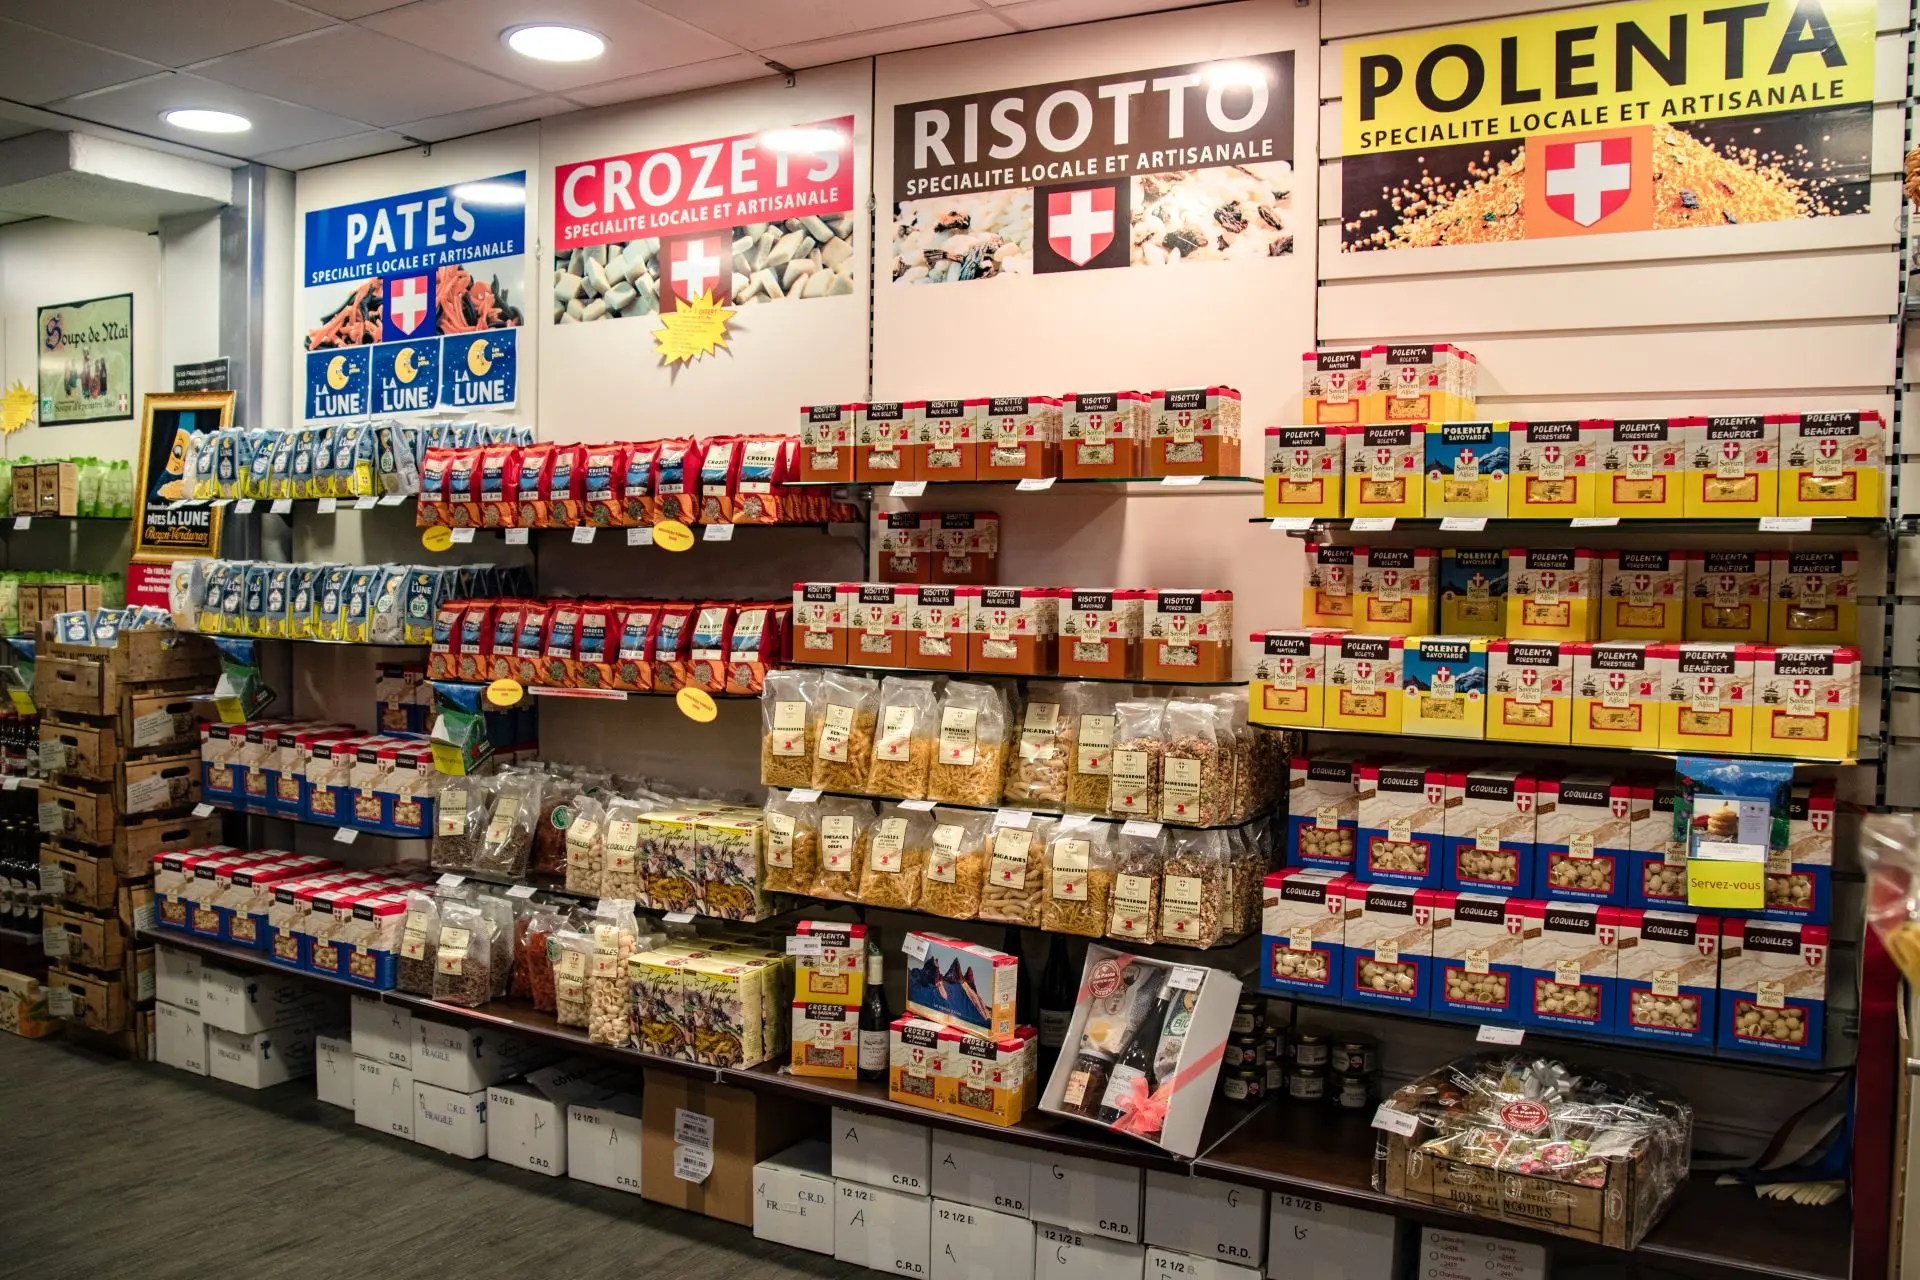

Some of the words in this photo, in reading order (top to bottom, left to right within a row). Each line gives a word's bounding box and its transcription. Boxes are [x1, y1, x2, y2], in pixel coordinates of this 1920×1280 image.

[1360, 0, 1849, 122] POLENTA
[915, 68, 1270, 170] RISOTTO
[1361, 118, 1499, 149] SPECIALITE
[1510, 106, 1608, 133] LOCALE
[1621, 101, 1650, 121] ET
[1661, 79, 1844, 117] ARTISANALE
[563, 128, 839, 217] CROZETS
[906, 168, 1014, 195] SPECIALITE
[1021, 158, 1098, 182] LOCALE
[1105, 155, 1128, 173] ET
[1137, 139, 1273, 169] ARTISANALE
[564, 216, 645, 239] SPECIALITE
[650, 207, 708, 227] LOCALE
[714, 203, 731, 219] ET
[737, 187, 838, 216] ARTISANALE
[347, 197, 475, 259] PATES
[312, 263, 372, 283] SPECIALITE
[377, 256, 418, 274] LOCALE
[423, 253, 436, 266] ET
[440, 241, 513, 263] ARTISANALE
[46, 315, 85, 350] Soupe
[89, 326, 100, 342] de
[102, 322, 128, 341] Mai
[1392, 348, 1427, 357] POLENTA
[1323, 354, 1355, 363] POLENTA
[455, 370, 469, 382] LA
[383, 378, 396, 389] LA
[316, 385, 329, 395] LA
[455, 380, 504, 404] LUNE
[383, 387, 428, 410] LUNE
[995, 398, 1022, 406] RISOTTO
[1171, 394, 1200, 402] RISOTTO
[315, 393, 359, 416] LUNE
[872, 403, 897, 411] RISOTTO
[931, 400, 958, 408] RISOTTO
[1714, 418, 1756, 426] POLENTA
[1806, 414, 1852, 422] POLENTA
[1369, 429, 1405, 437] POLENTA
[1443, 426, 1491, 435] POLENTA
[1533, 425, 1572, 433] POLENTA
[1620, 424, 1661, 432] POLENTA
[1804, 426, 1853, 435] BEAUFORT
[1286, 431, 1320, 439] POLENTA
[1712, 430, 1759, 439] BEAUFORT
[176, 511, 210, 526] LUNE
[1532, 553, 1568, 561] POLENTA
[1793, 565, 1837, 573] BEAUFORT
[412, 586, 432, 595] LUNE
[864, 587, 889, 595] RISOTTO
[923, 589, 948, 597] RISOTTO
[987, 590, 1014, 598] RISOTTO
[1164, 597, 1194, 605] RISOTTO
[1270, 639, 1304, 648] POLENTA
[1347, 642, 1383, 651] POLENTA
[1421, 644, 1467, 653] POLENTA
[1514, 648, 1552, 657] POLENTA
[1598, 652, 1638, 660] POLENTA
[1685, 651, 1728, 660] POLENTA
[1781, 653, 1826, 661] POLENTA
[1683, 665, 1729, 673] BEAUFORT
[1312, 768, 1346, 776] COQUILLES
[1383, 777, 1418, 786] COQUILLES
[1470, 785, 1508, 794] COQUILLES
[1564, 790, 1603, 800] COQUILLES
[1691, 878, 1761, 891] Servez-vous
[1286, 887, 1321, 897] COQUILLES
[1370, 898, 1407, 908] COQUILLES
[1460, 906, 1498, 917] COQUILLES
[1550, 917, 1590, 927] COQUILLES
[1647, 925, 1689, 937] COQUILLES
[1750, 935, 1793, 947] COQUILLES
[904, 1027, 935, 1037] CROZETS
[962, 1037, 994, 1048] CROZETS
[389, 1052, 407, 1063] C.R.D.
[422, 1048, 450, 1061] FRAGILE
[491, 1093, 498, 1101] 12
[500, 1095, 508, 1104] 1/2
[425, 1111, 454, 1126] FRAGILE
[583, 1115, 593, 1124] 1/2
[534, 1113, 545, 1137] A
[609, 1128, 618, 1145] A
[845, 1128, 858, 1143] A
[530, 1156, 549, 1168] C.R.D.
[943, 1152, 956, 1169] A
[617, 1177, 640, 1188] C.R.D.
[892, 1175, 920, 1188] C.R.D.
[798, 1191, 825, 1204] C.R.D.
[842, 1188, 854, 1197] 12
[854, 1190, 867, 1200] 1/2
[1450, 1189, 1482, 1202] HORS
[995, 1196, 1025, 1211] C.R.D.
[1280, 1195, 1293, 1206] 12
[1296, 1198, 1312, 1209] 1/2
[1314, 1202, 1325, 1212] B.
[850, 1209, 864, 1227] A
[939, 1210, 950, 1220] 12
[952, 1213, 966, 1223] 1/2
[1099, 1220, 1131, 1235] C.R.D.
[1045, 1230, 1056, 1240] 12
[1057, 1233, 1072, 1244] 1/2
[1074, 1236, 1084, 1246] B.
[1217, 1243, 1251, 1259] C.R.D.
[896, 1260, 924, 1274] C.R.D.
[1155, 1258, 1167, 1268] 12
[1169, 1261, 1185, 1273] 1/2
